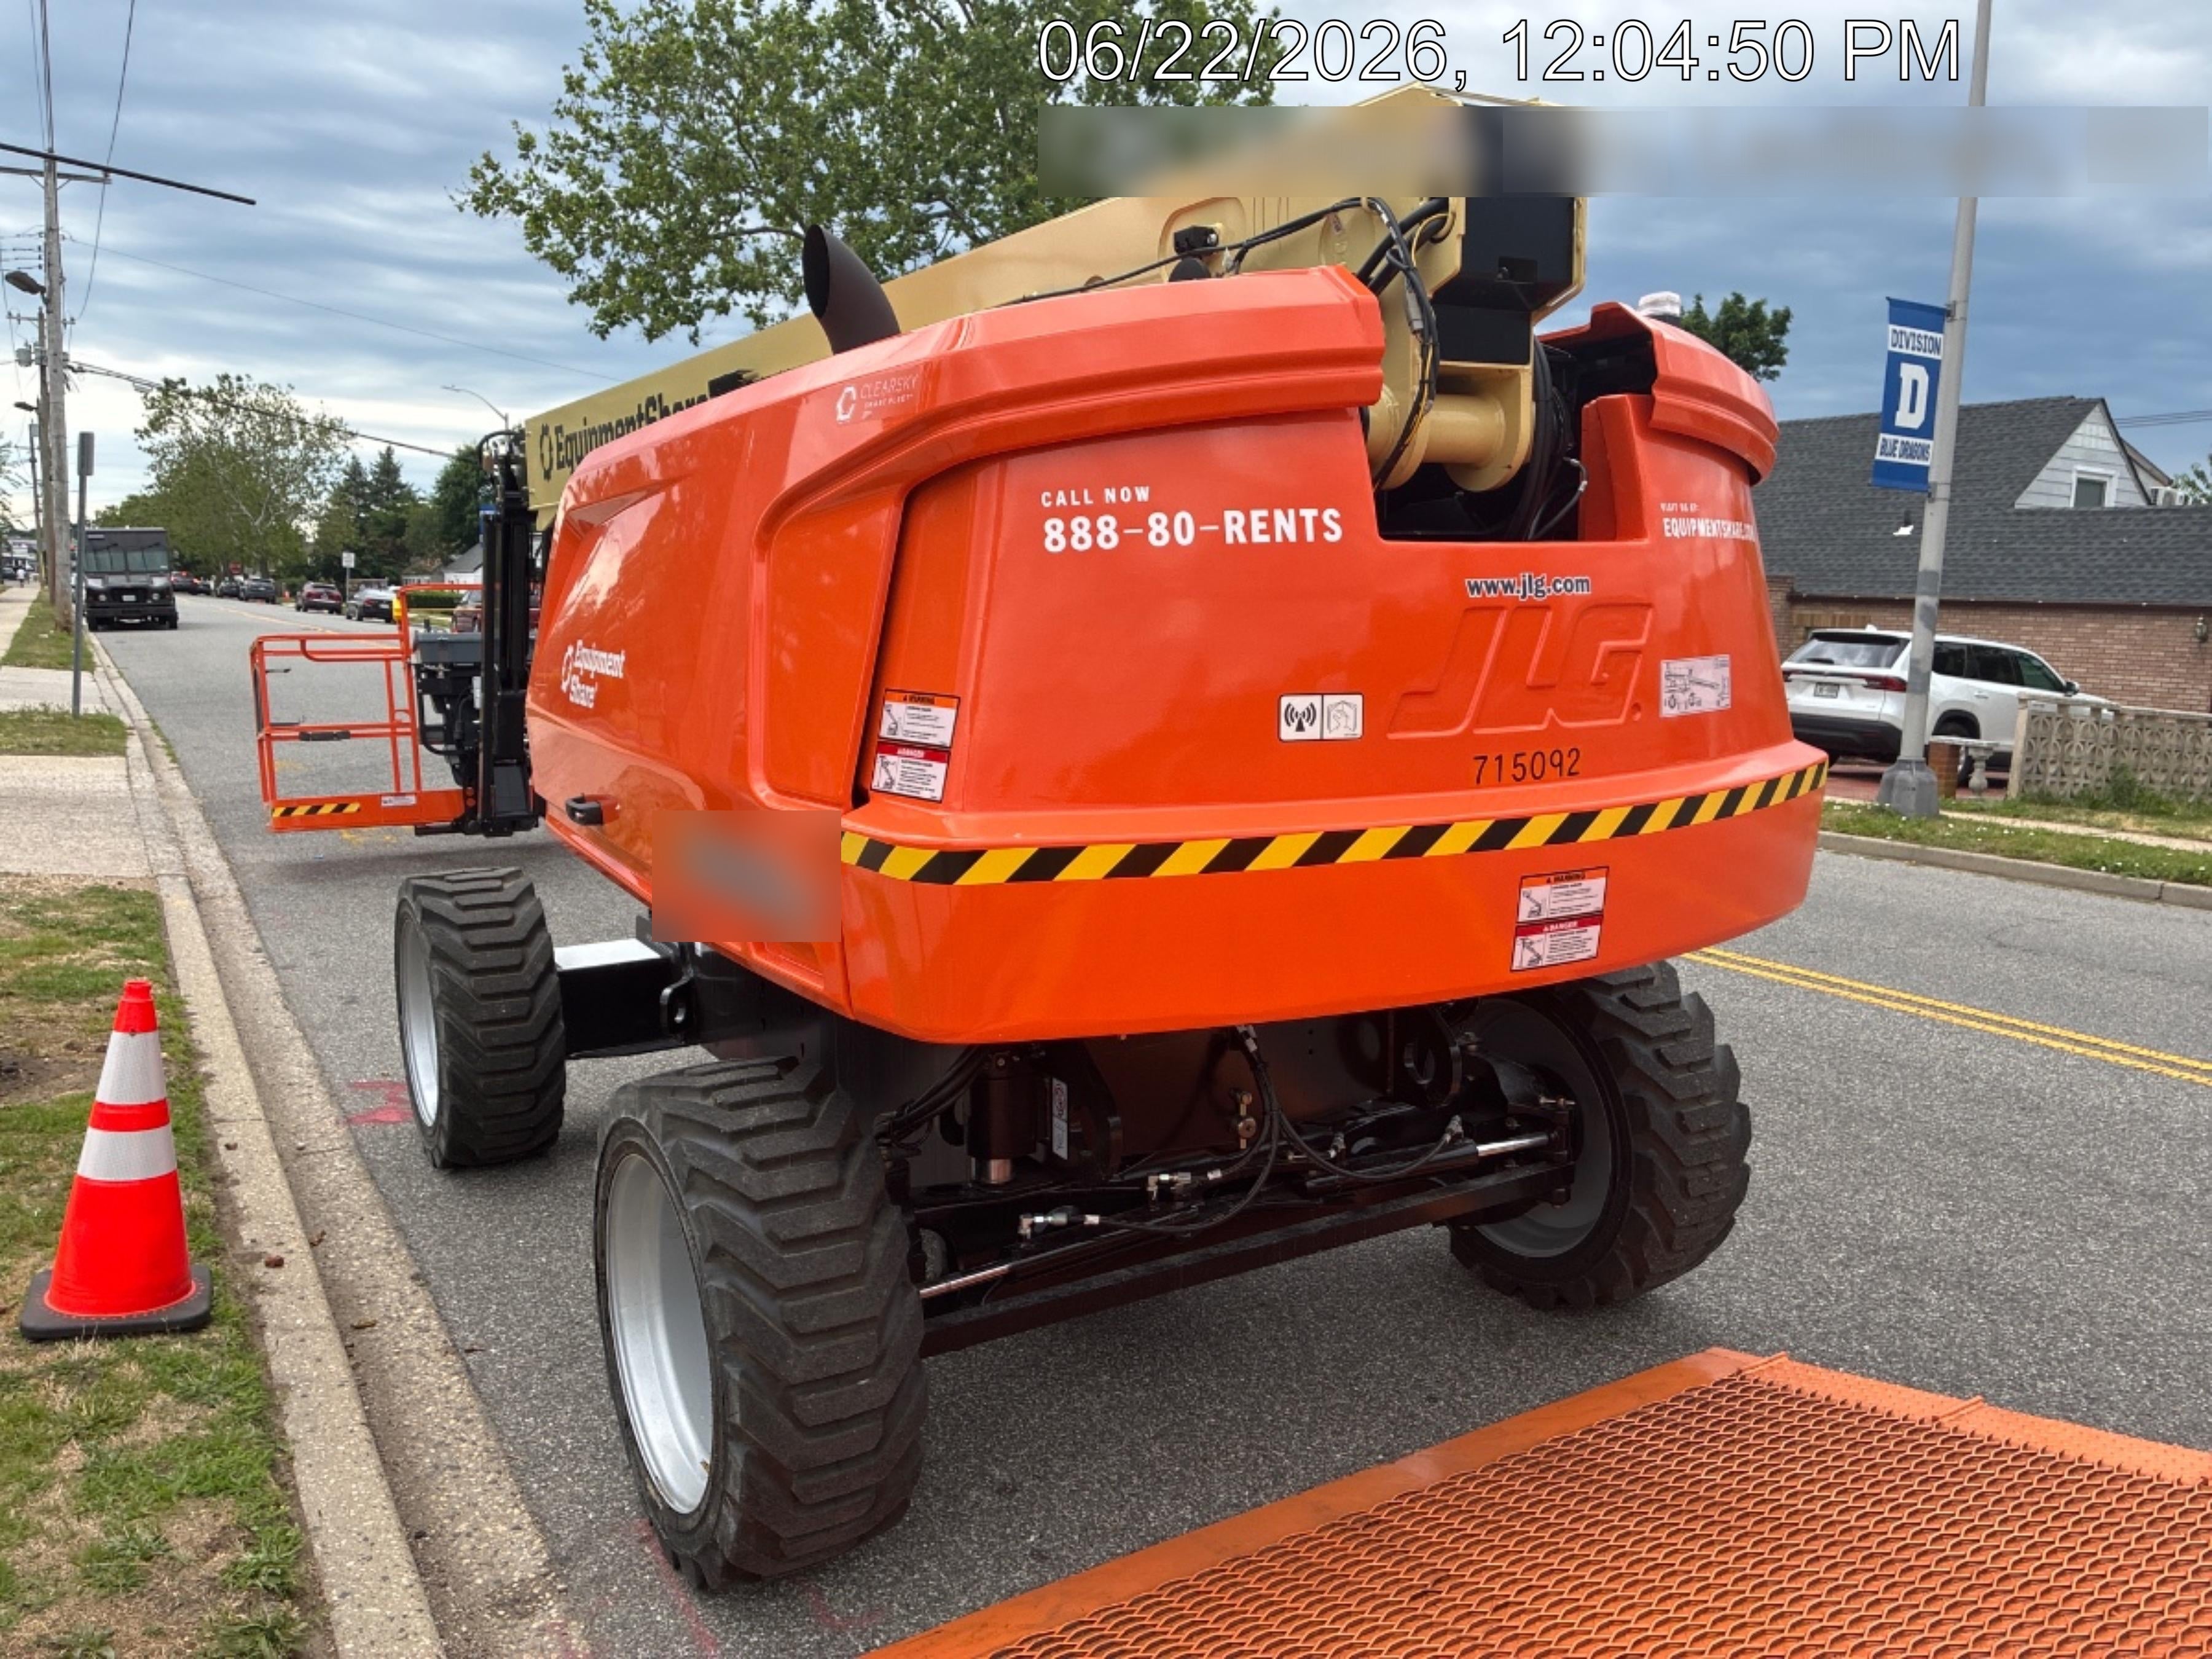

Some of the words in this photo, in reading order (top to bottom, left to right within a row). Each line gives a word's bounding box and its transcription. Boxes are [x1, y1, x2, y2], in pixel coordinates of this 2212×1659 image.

[1891, 328, 1942, 356] DIVISION
[861, 374, 919, 398] CLEARSKY
[1894, 363, 1929, 429] D
[1880, 437, 1899, 458] BLUE
[1041, 489, 1093, 507] CALL
[1104, 486, 1150, 503] NOW
[1044, 508, 1343, 553] 888-80-RENTS
[1466, 573, 1591, 600] www.jlg.com
[1387, 603, 1654, 739] JLG
[1473, 747, 1581, 785] 715092
